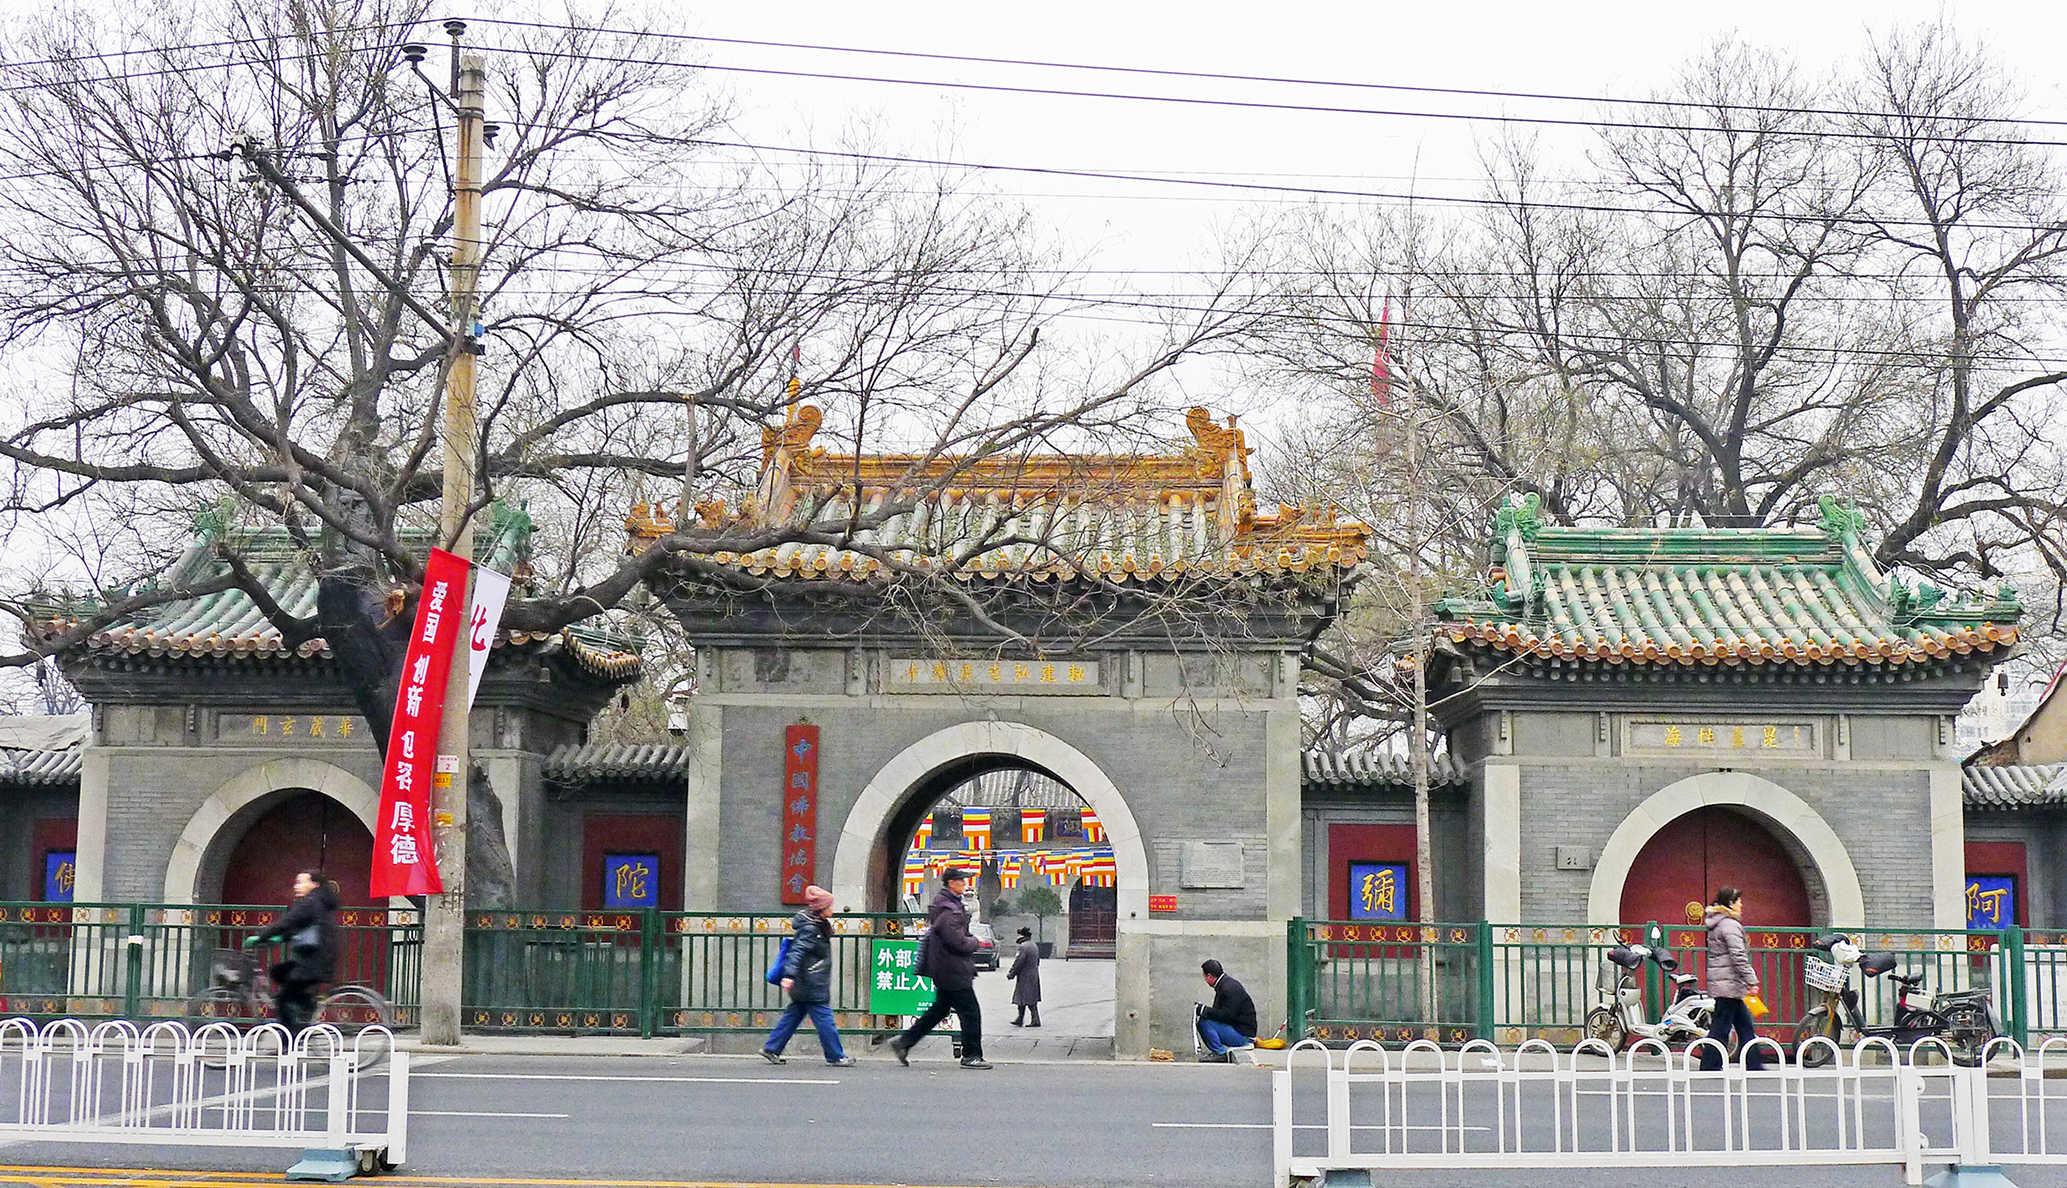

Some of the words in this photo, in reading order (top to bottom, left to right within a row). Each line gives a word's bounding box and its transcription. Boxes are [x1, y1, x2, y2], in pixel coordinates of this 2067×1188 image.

[422, 580, 448, 644] 爱国
[406, 653, 430, 717] 创新
[445, 763, 451, 771] 2
[390, 801, 419, 865] 厚德
[615, 862, 649, 898] 陀
[1361, 868, 1395, 913] 彌
[1965, 882, 2009, 923] 阿
